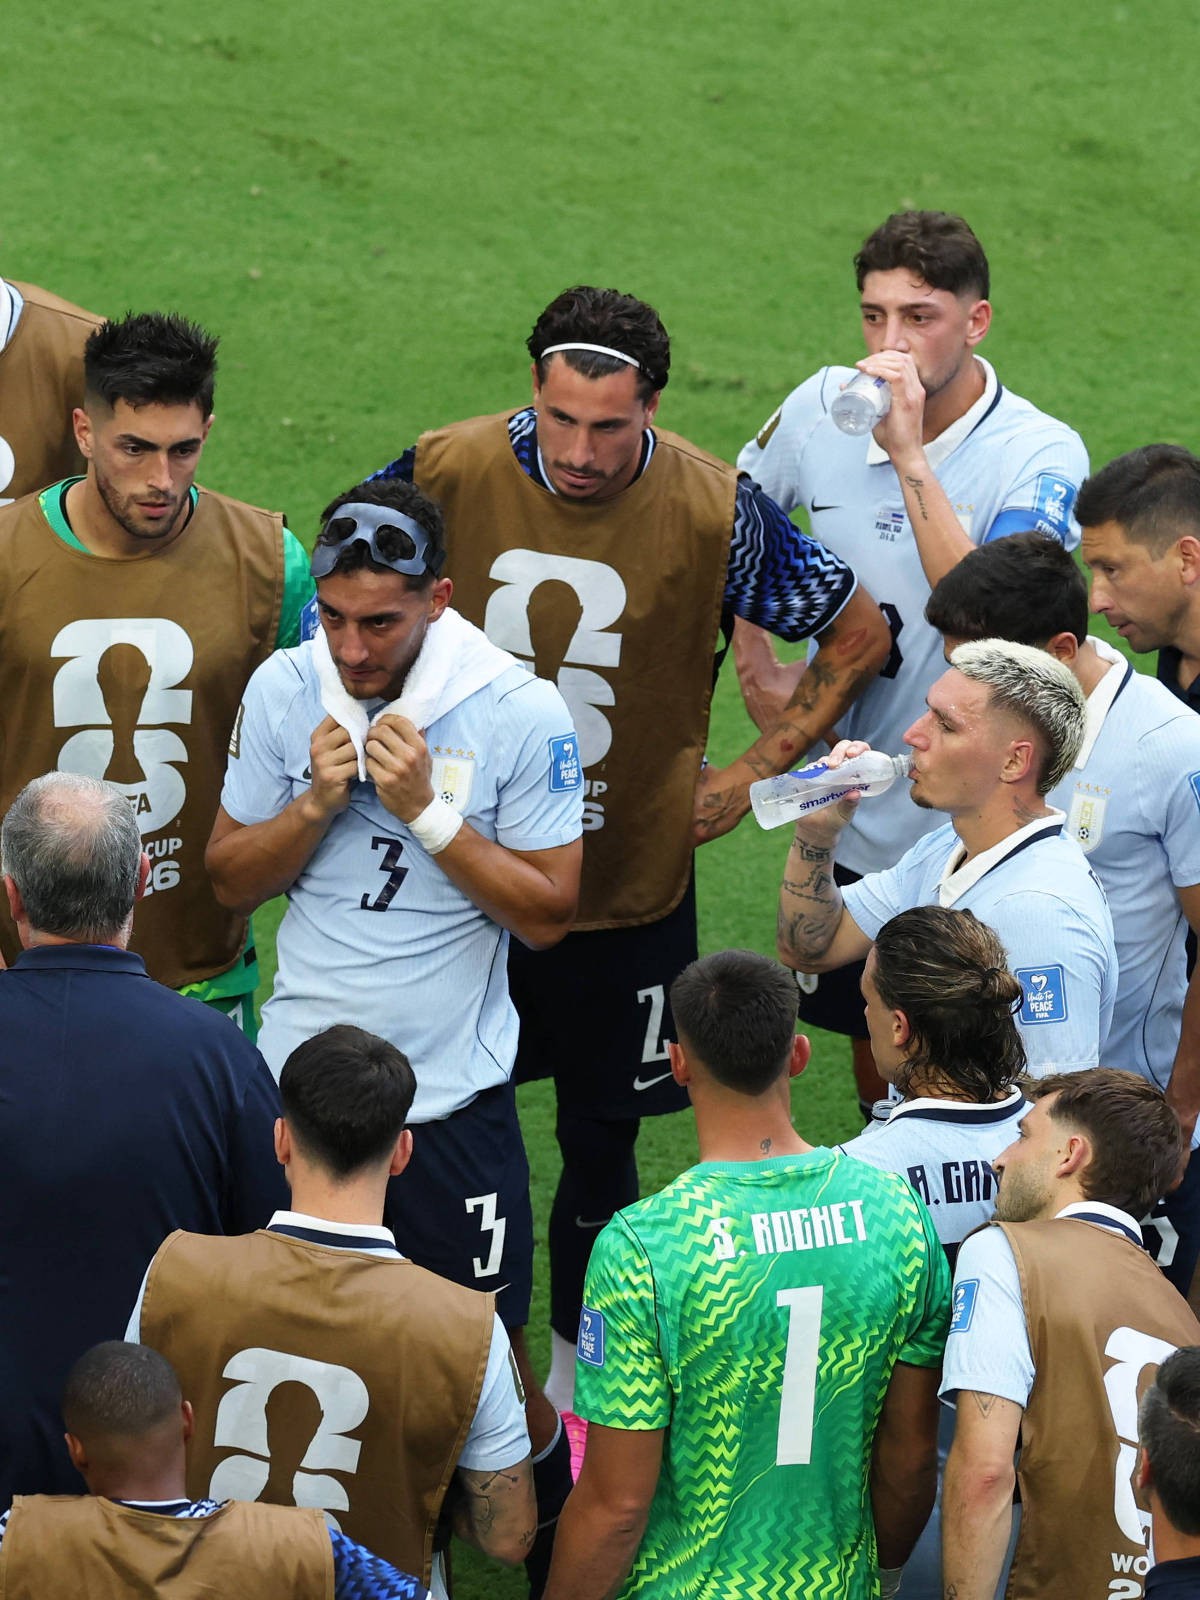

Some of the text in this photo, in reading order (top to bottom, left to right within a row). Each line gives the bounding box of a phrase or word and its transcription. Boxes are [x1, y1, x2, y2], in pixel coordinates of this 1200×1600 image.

[145, 837, 183, 861] CUP
[360, 835, 410, 912] 3
[1030, 1000, 1054, 1013] PEACE
[465, 1192, 506, 1278] 3
[710, 1200, 867, 1261] S. ROCHET
[776, 1285, 824, 1466] 1
